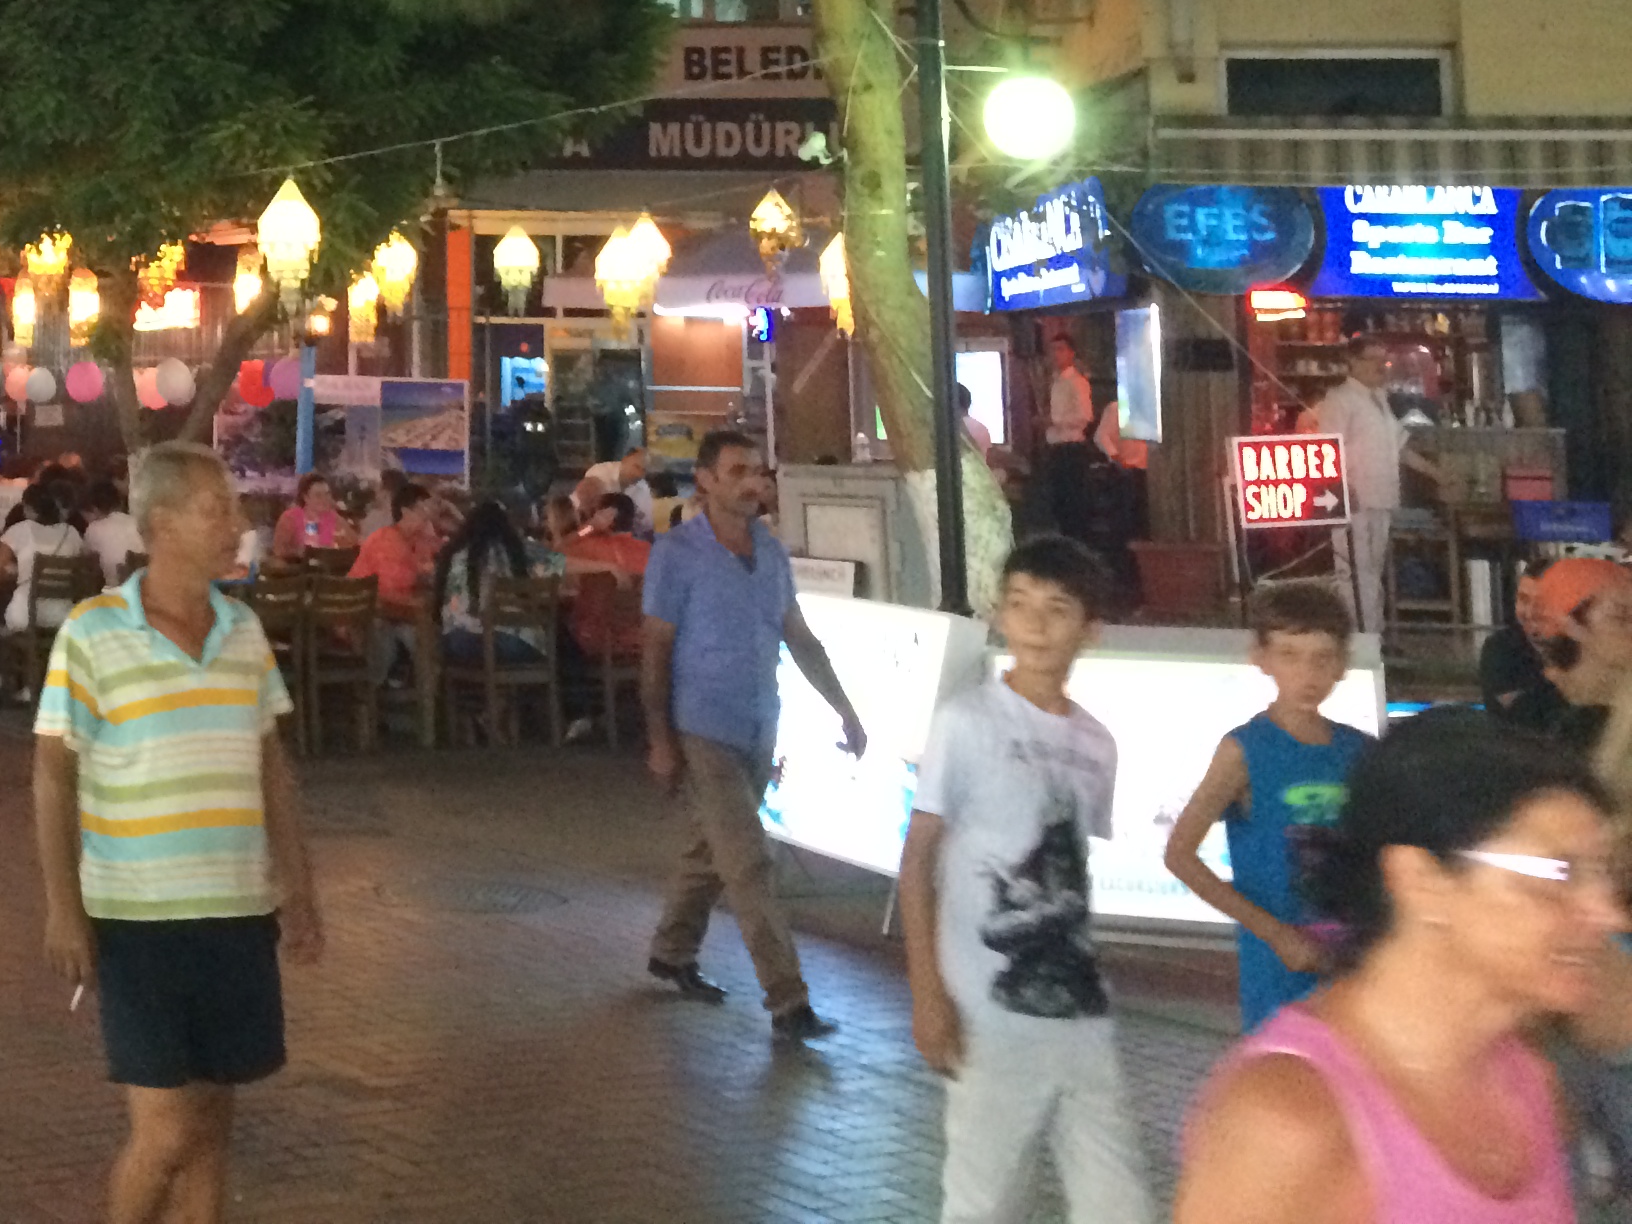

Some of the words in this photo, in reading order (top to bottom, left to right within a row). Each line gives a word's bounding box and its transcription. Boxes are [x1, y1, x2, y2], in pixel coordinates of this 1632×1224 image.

[683, 44, 824, 80] BELED
[1164, 203, 1277, 241] EFES
[1242, 443, 1338, 481] BARBER
[1245, 482, 1307, 520] SHOP
